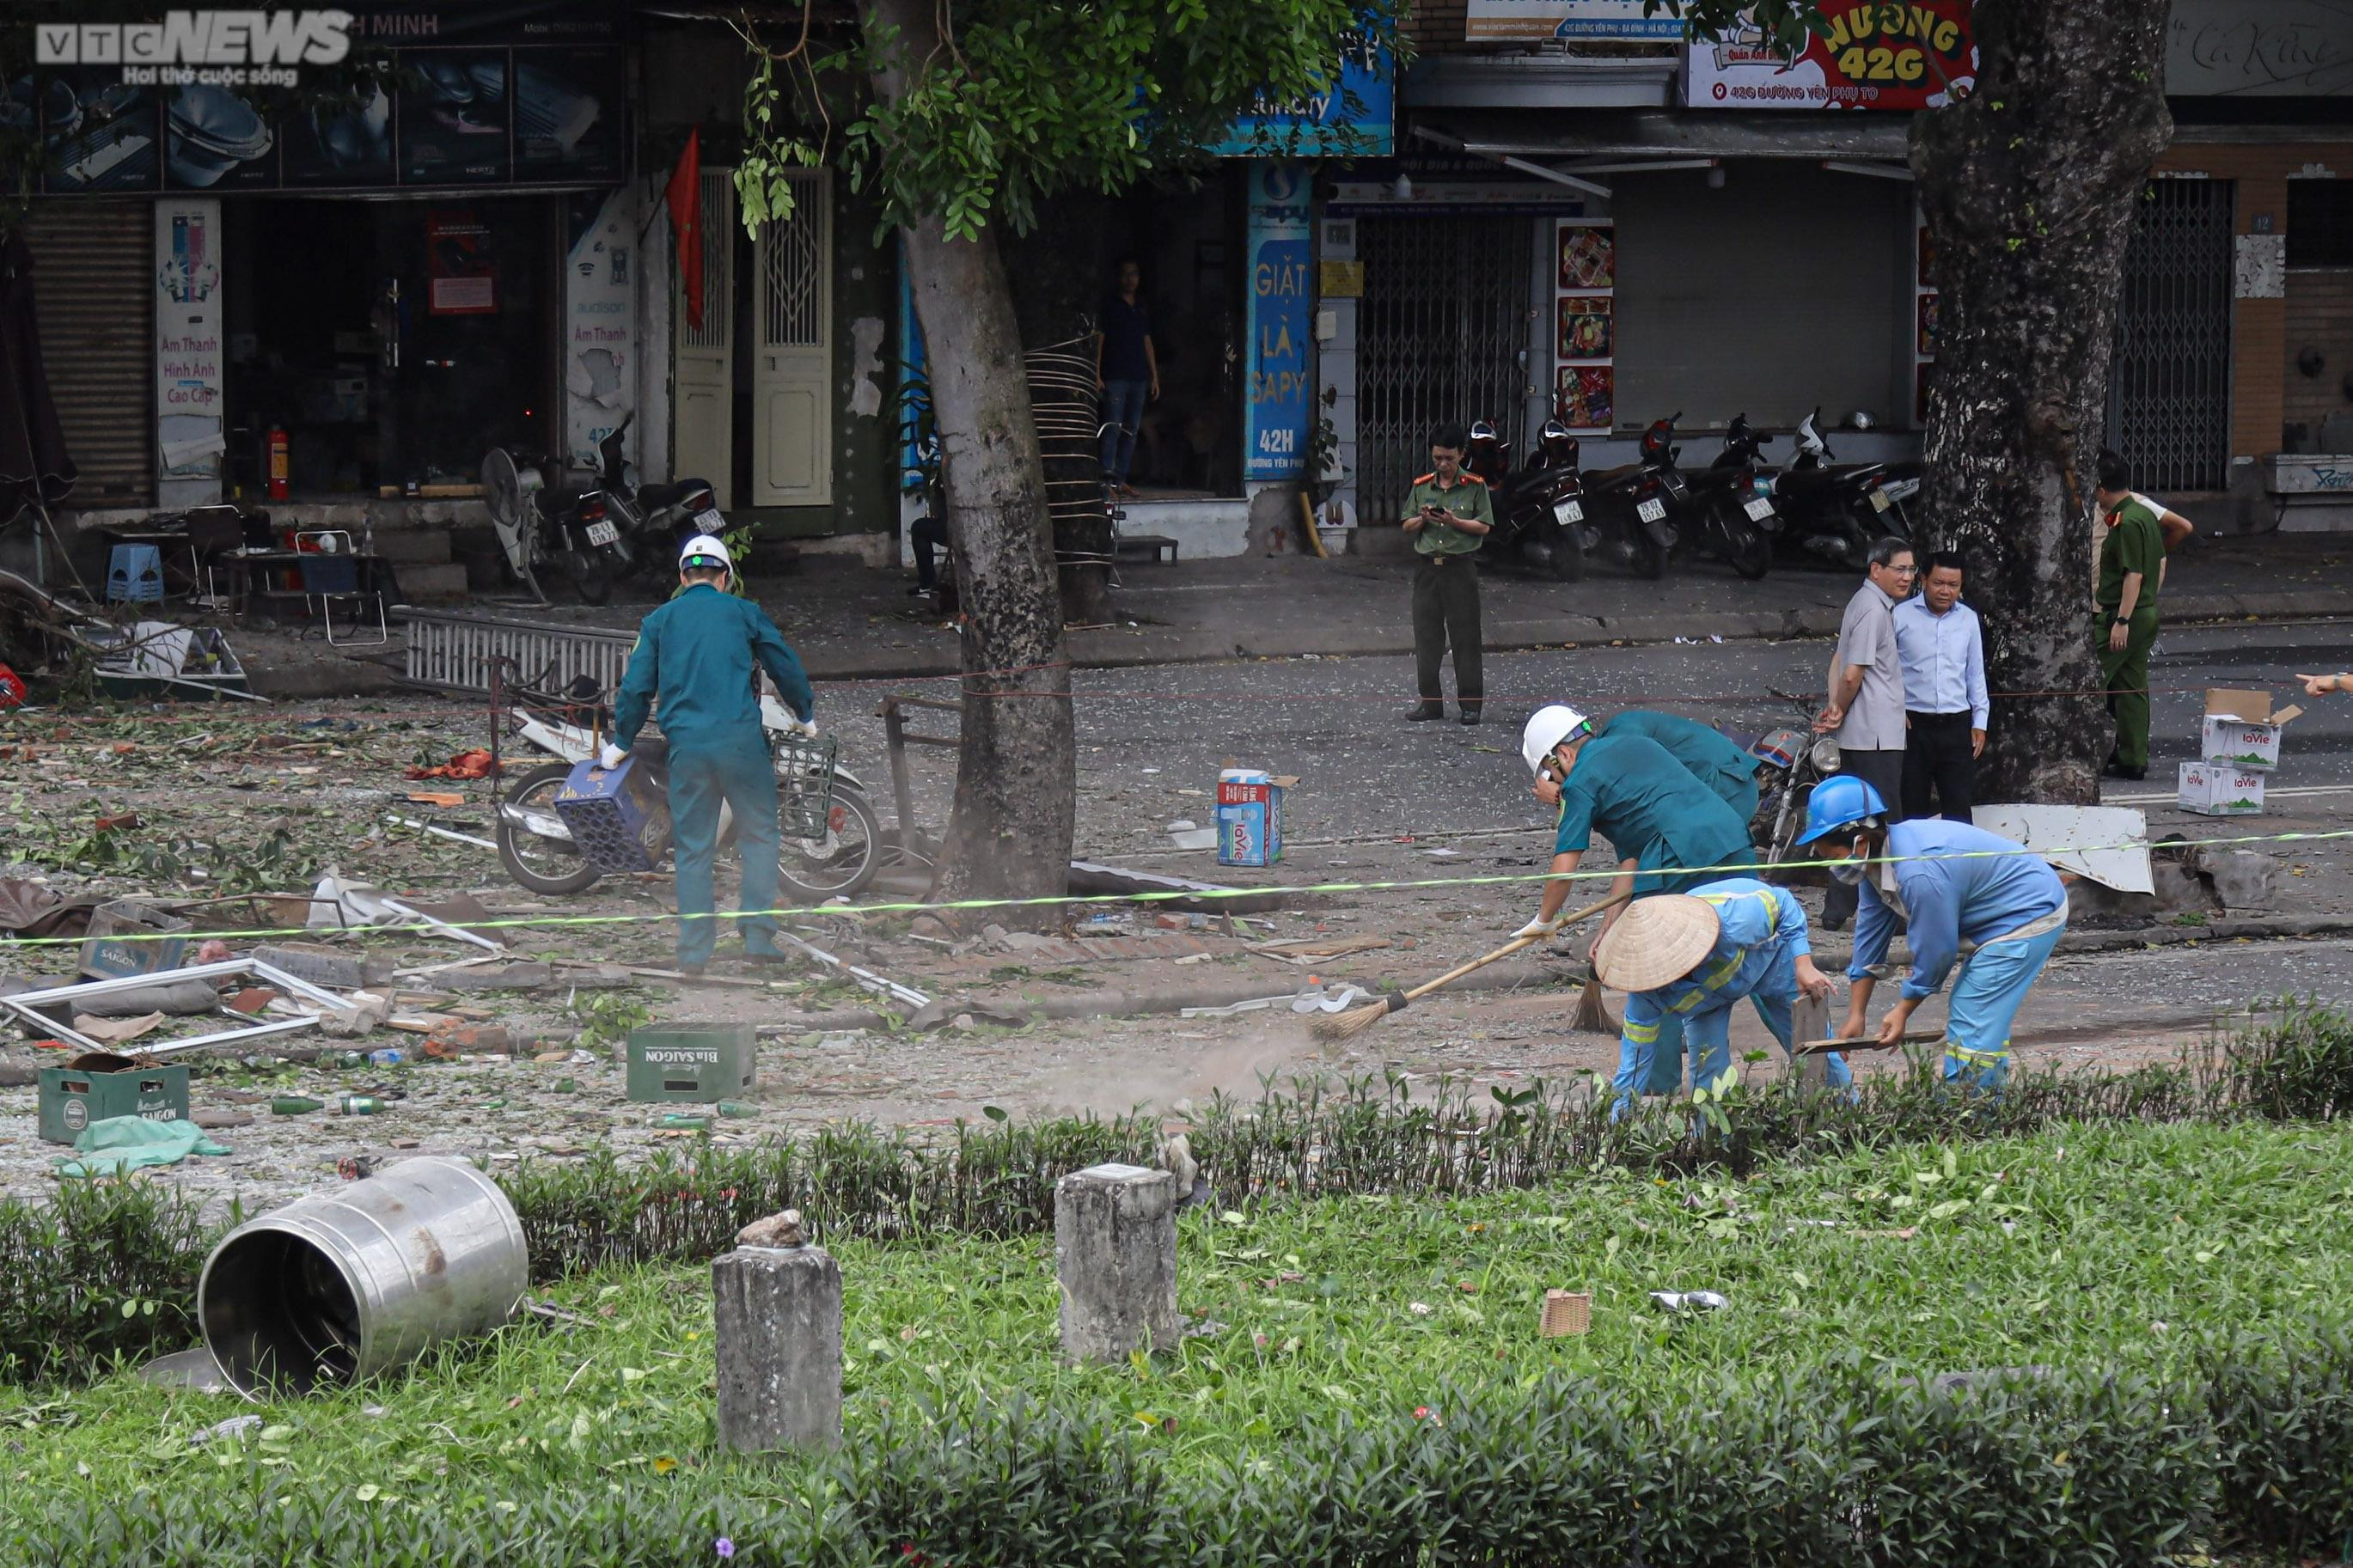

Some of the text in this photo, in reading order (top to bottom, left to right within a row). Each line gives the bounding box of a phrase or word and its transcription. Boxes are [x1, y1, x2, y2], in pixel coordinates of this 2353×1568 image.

[372, 14, 439, 35] MINH
[1595, 22, 1605, 33] YÊN
[1607, 24, 1617, 34] PHỤ
[1648, 23, 1656, 33] HÀ
[1729, 49, 1748, 61] Quán
[1838, 47, 1924, 80] 42G
[1731, 87, 1756, 99] 42G
[1806, 85, 1830, 100] YÊN
[1255, 255, 1305, 304] GIẶT
[594, 326, 626, 342] Thanh
[1262, 314, 1293, 357] LÀ
[182, 336, 217, 352] Thanh
[168, 387, 188, 403] Cao
[1250, 371, 1305, 404] SAPY
[1260, 429, 1293, 452] 42H
[1274, 456, 1288, 468] YÊN
[2242, 733, 2270, 744] laVie
[2187, 775, 2203, 786] laVie
[2234, 778, 2257, 788] laVie
[1234, 824, 1247, 861] laVie
[100, 948, 137, 967] SAIGON
[645, 1051, 718, 1063] Bia SAIGON
[142, 1107, 177, 1121] SAIGON
